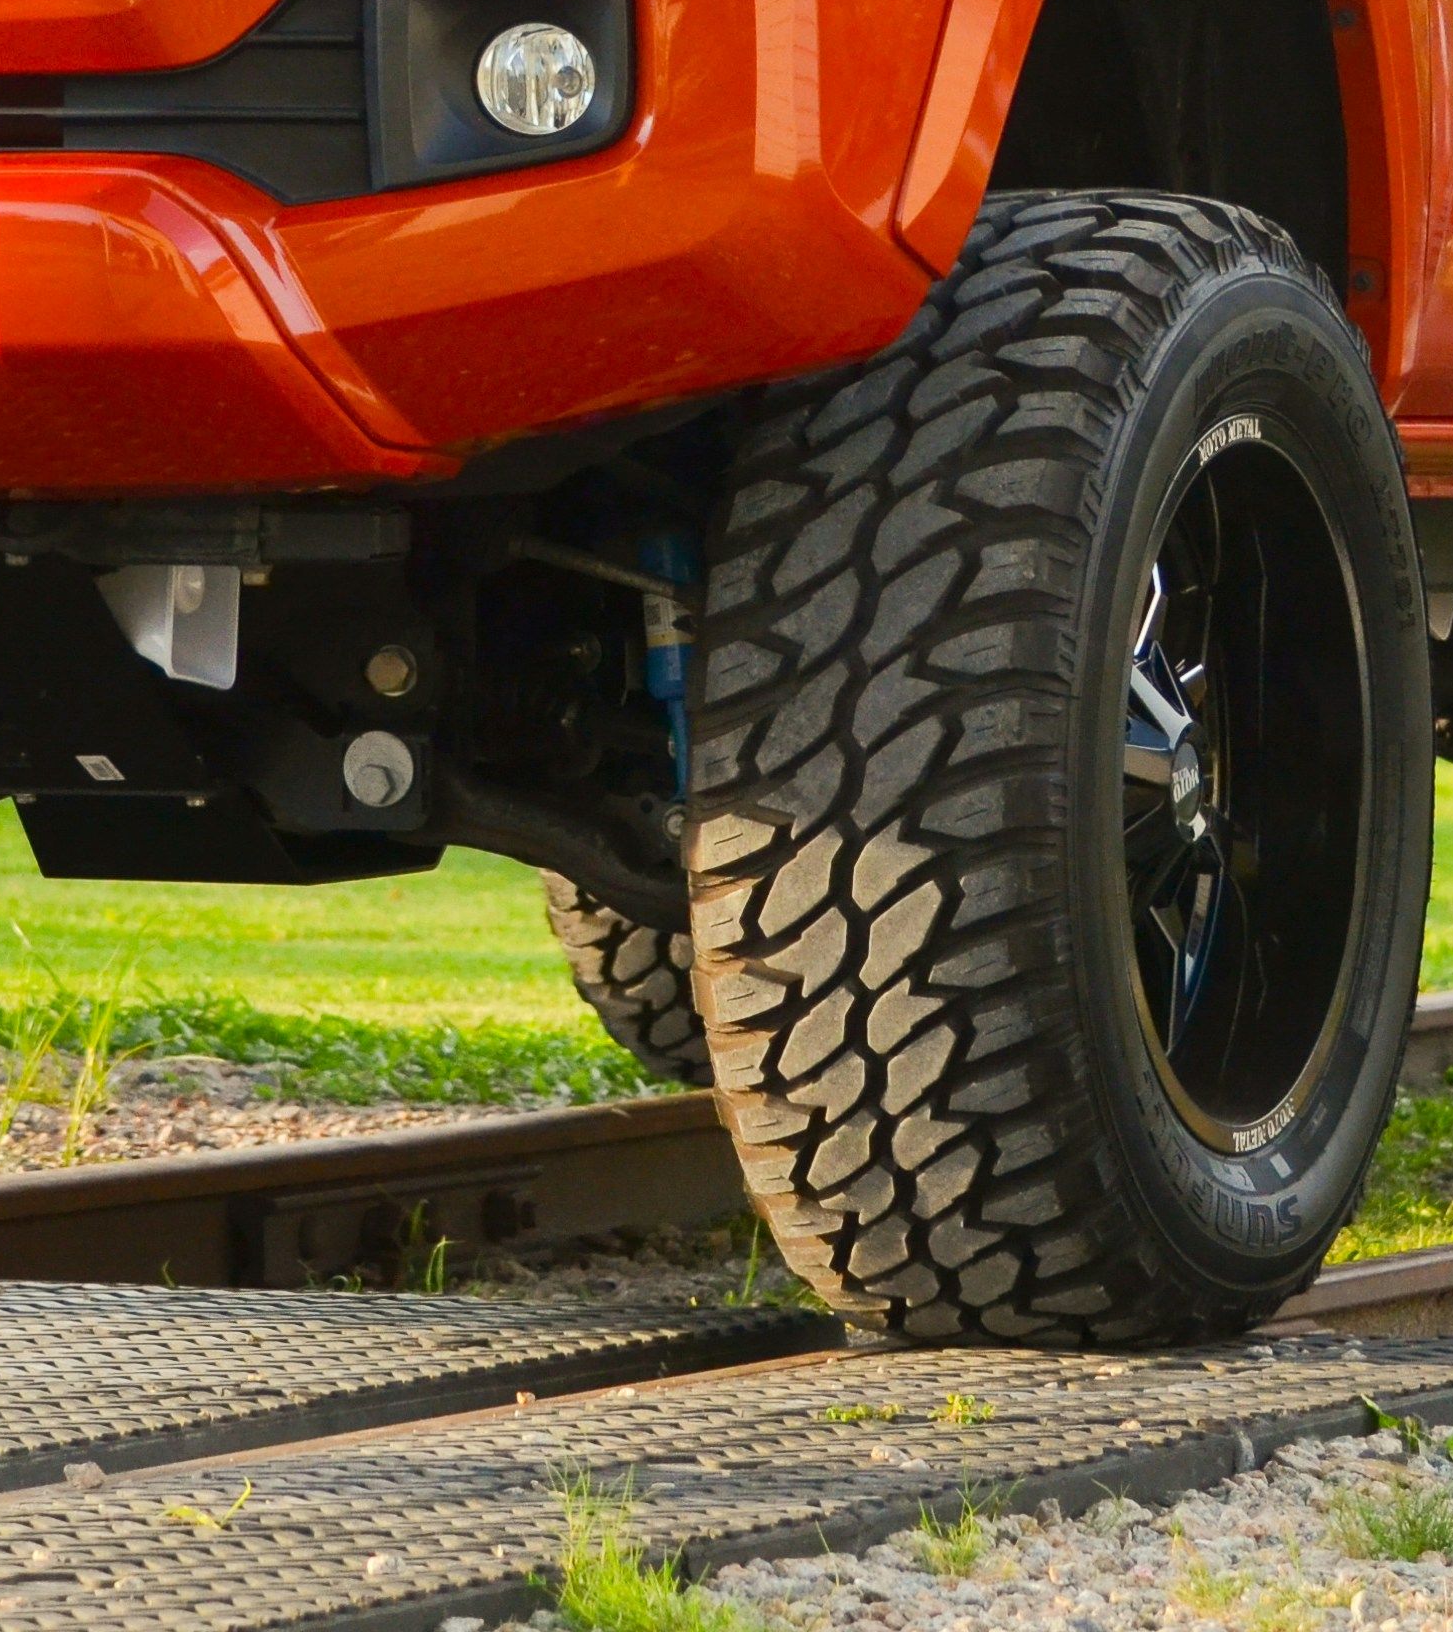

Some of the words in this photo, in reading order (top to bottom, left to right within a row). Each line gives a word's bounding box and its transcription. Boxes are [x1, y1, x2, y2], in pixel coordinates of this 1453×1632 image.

[1198, 427, 1227, 466] MOTO
[1227, 418, 1262, 444] METAL
[1265, 1096, 1296, 1140] MOTO
[1232, 1131, 1268, 1153] METAL
